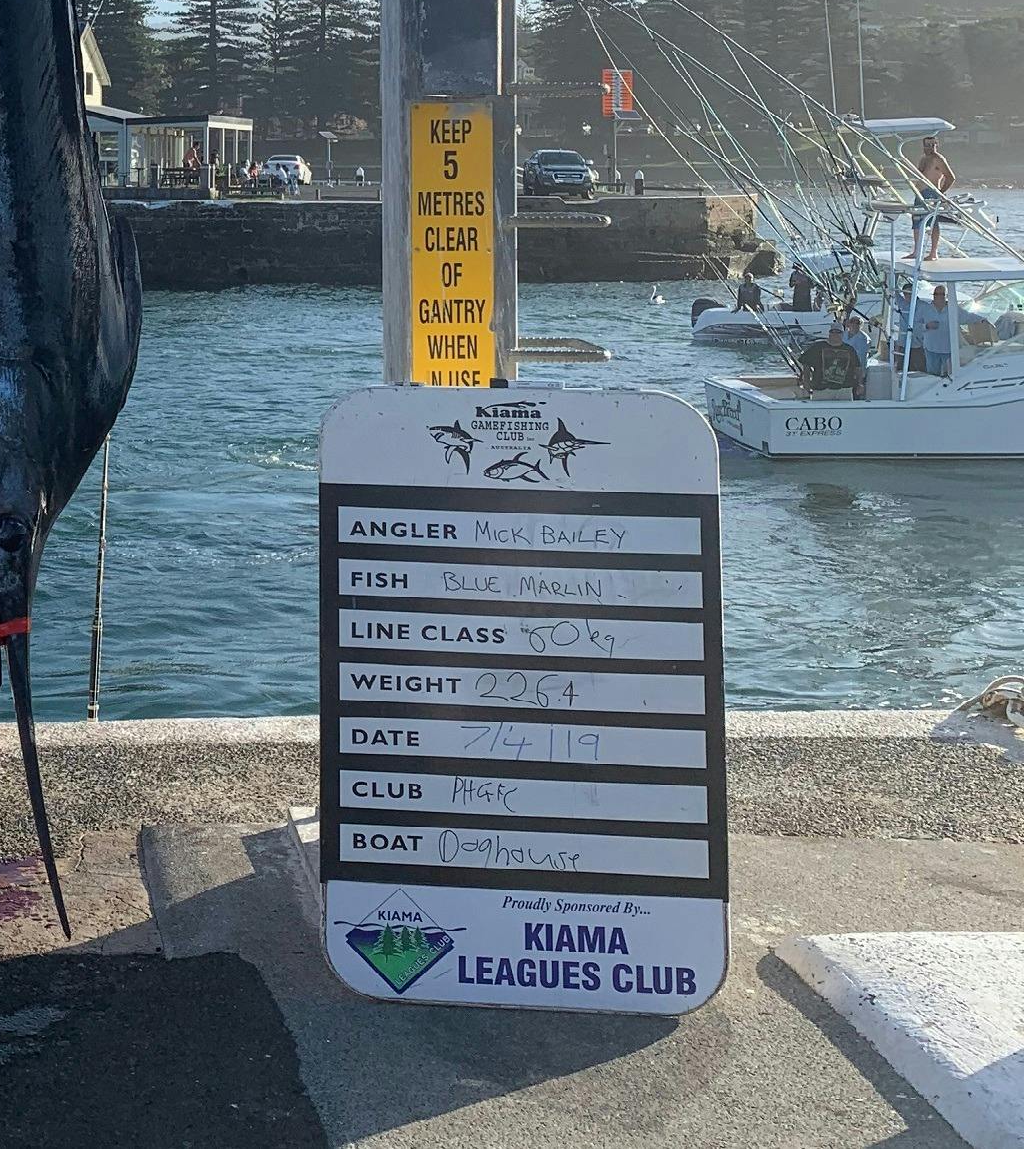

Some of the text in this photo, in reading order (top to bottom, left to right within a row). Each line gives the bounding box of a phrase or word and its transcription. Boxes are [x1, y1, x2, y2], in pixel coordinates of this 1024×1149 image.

[430, 119, 473, 144] KEEP
[443, 150, 459, 180] 5
[418, 191, 485, 216] METRES
[425, 226, 478, 252] CLEAR
[441, 262, 463, 288] OF
[419, 299, 486, 325] GANTRY
[427, 335, 478, 360] WHEN
[475, 407, 542, 419] Kiama
[785, 416, 842, 431] CABO
[471, 421, 549, 431] GAMEFISHING
[496, 431, 524, 441] CLUB
[350, 520, 458, 540] ANGLER
[540, 524, 626, 549] BAILEY
[350, 571, 409, 589] FISH
[442, 571, 602, 598] BLUE MARLIN
[351, 622, 505, 644] LINE CLASS
[350, 673, 462, 694] WEIGHT
[475, 671, 580, 708] 226.4
[352, 729, 420, 747] DATE
[460, 722, 600, 762] 7/4/19
[352, 781, 423, 800] CLUB
[352, 833, 423, 851] BOAT
[438, 829, 580, 873] Doghouse
[378, 911, 423, 923] KIAMA
[502, 895, 652, 917] Proudly Sponsored By...
[524, 922, 630, 955] KIAMA
[395, 935, 451, 985] LEAGUES CLUB
[458, 955, 697, 995] LEAGUES CLUB
